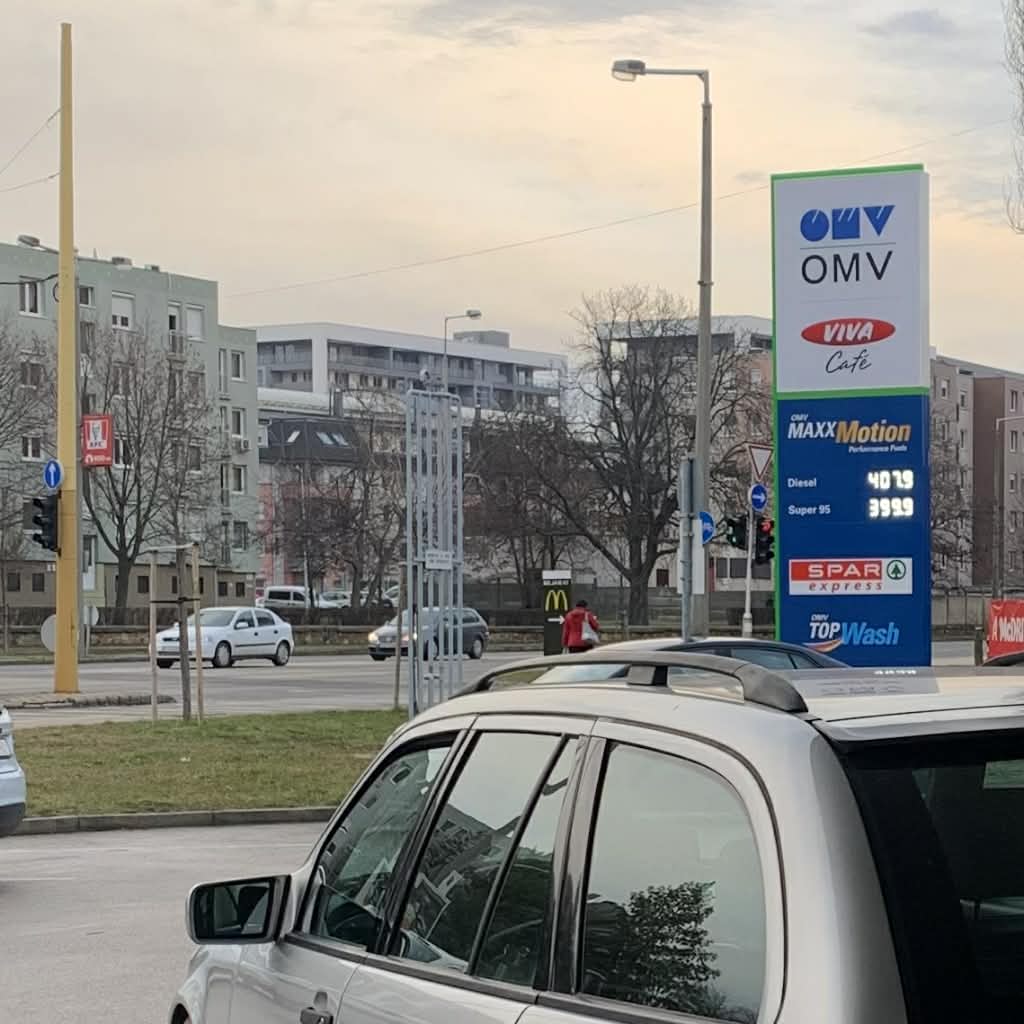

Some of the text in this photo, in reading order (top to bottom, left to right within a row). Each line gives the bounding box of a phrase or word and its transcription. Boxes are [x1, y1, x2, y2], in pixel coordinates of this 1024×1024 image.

[801, 251, 893, 284] OMV
[823, 321, 874, 342] VIVA
[825, 349, 872, 373] Café
[787, 478, 817, 488] Diesel
[788, 505, 816, 516] Super
[819, 505, 831, 514] 95
[808, 562, 882, 578] SPAR
[808, 581, 883, 593] express
[991, 616, 998, 641] A
